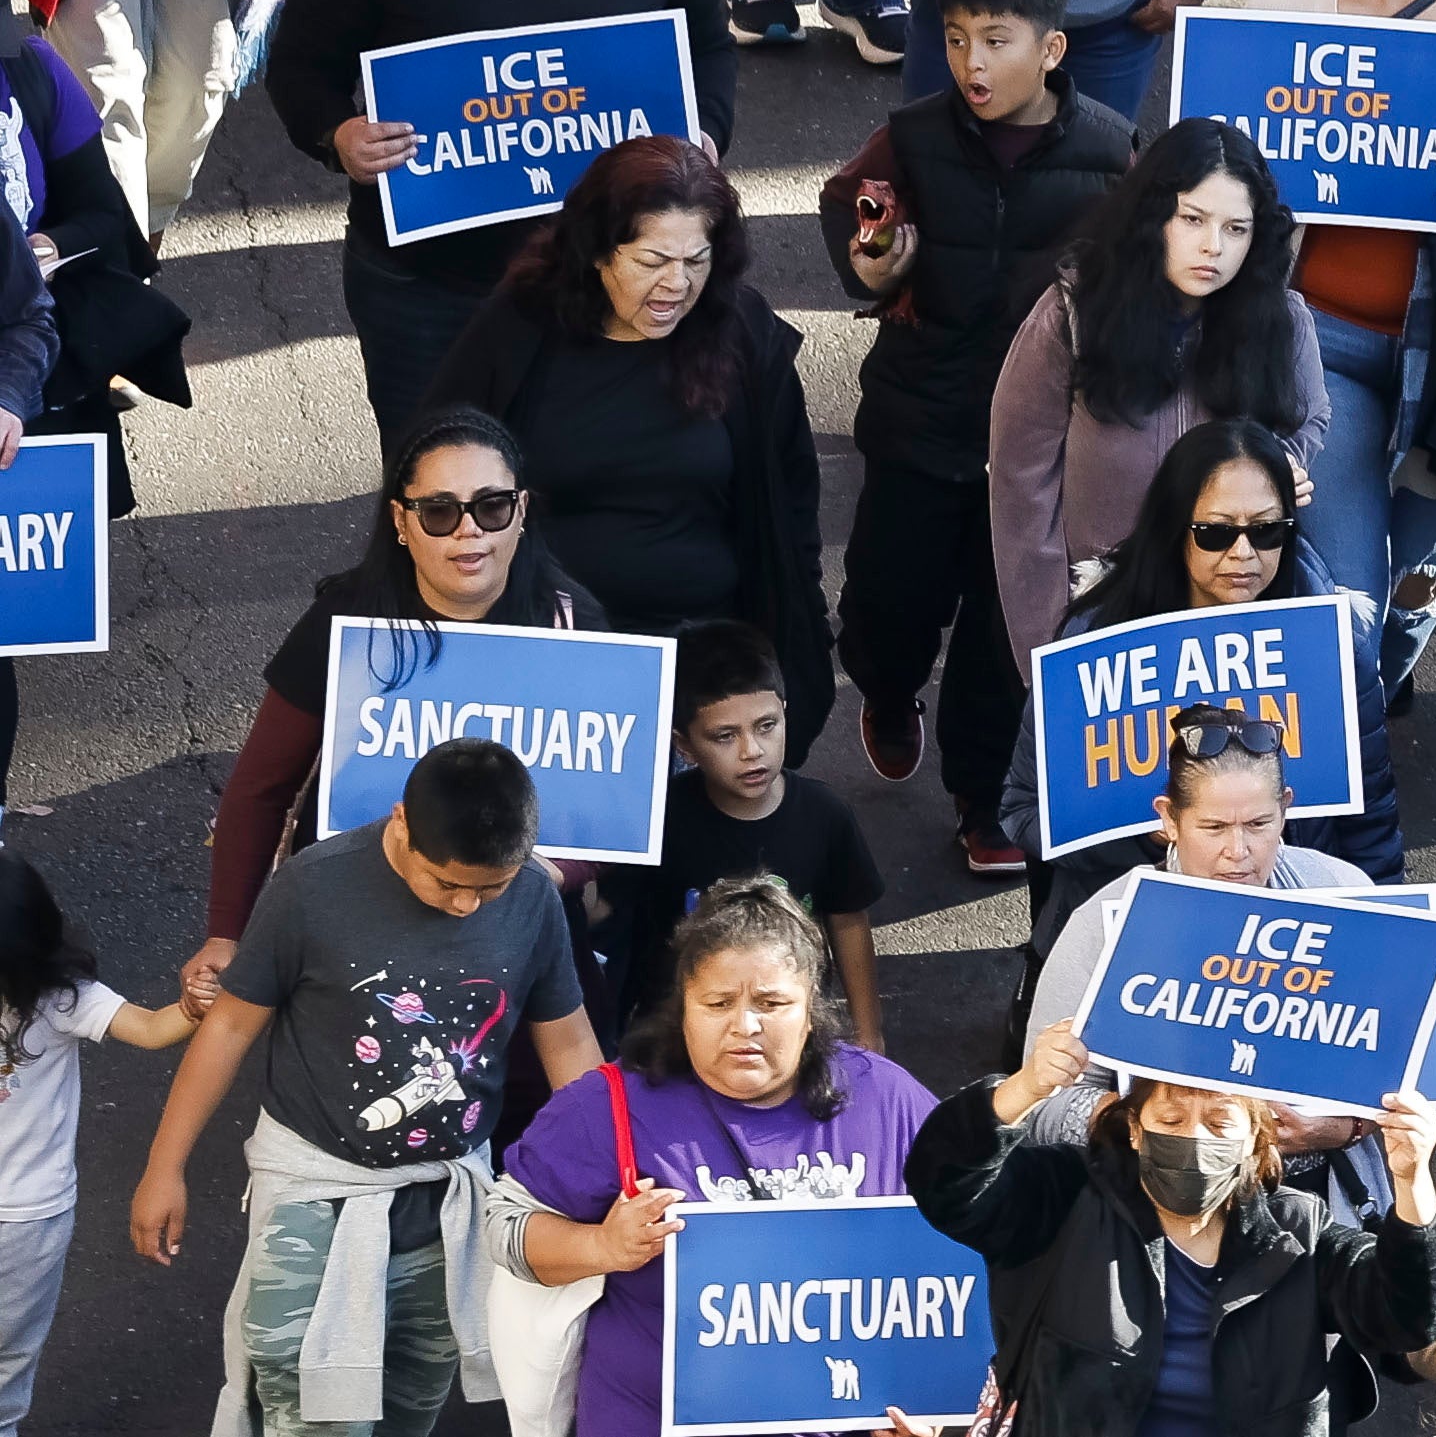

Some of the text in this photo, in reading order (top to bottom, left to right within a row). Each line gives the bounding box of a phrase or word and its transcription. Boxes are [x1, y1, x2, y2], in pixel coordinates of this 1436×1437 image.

[482, 46, 567, 94] ICE
[1292, 41, 1378, 90] ICE
[461, 85, 587, 124] OUT OF
[1264, 87, 1391, 120] OUT OF
[404, 107, 655, 177] CALIFORNIA
[1076, 626, 1289, 719] WE ARE
[1234, 913, 1332, 966] ICE
[1201, 955, 1334, 994] OUT OF
[1118, 973, 1381, 1053] CALIFORNIA
[698, 1274, 976, 1347] SANCTUARY
